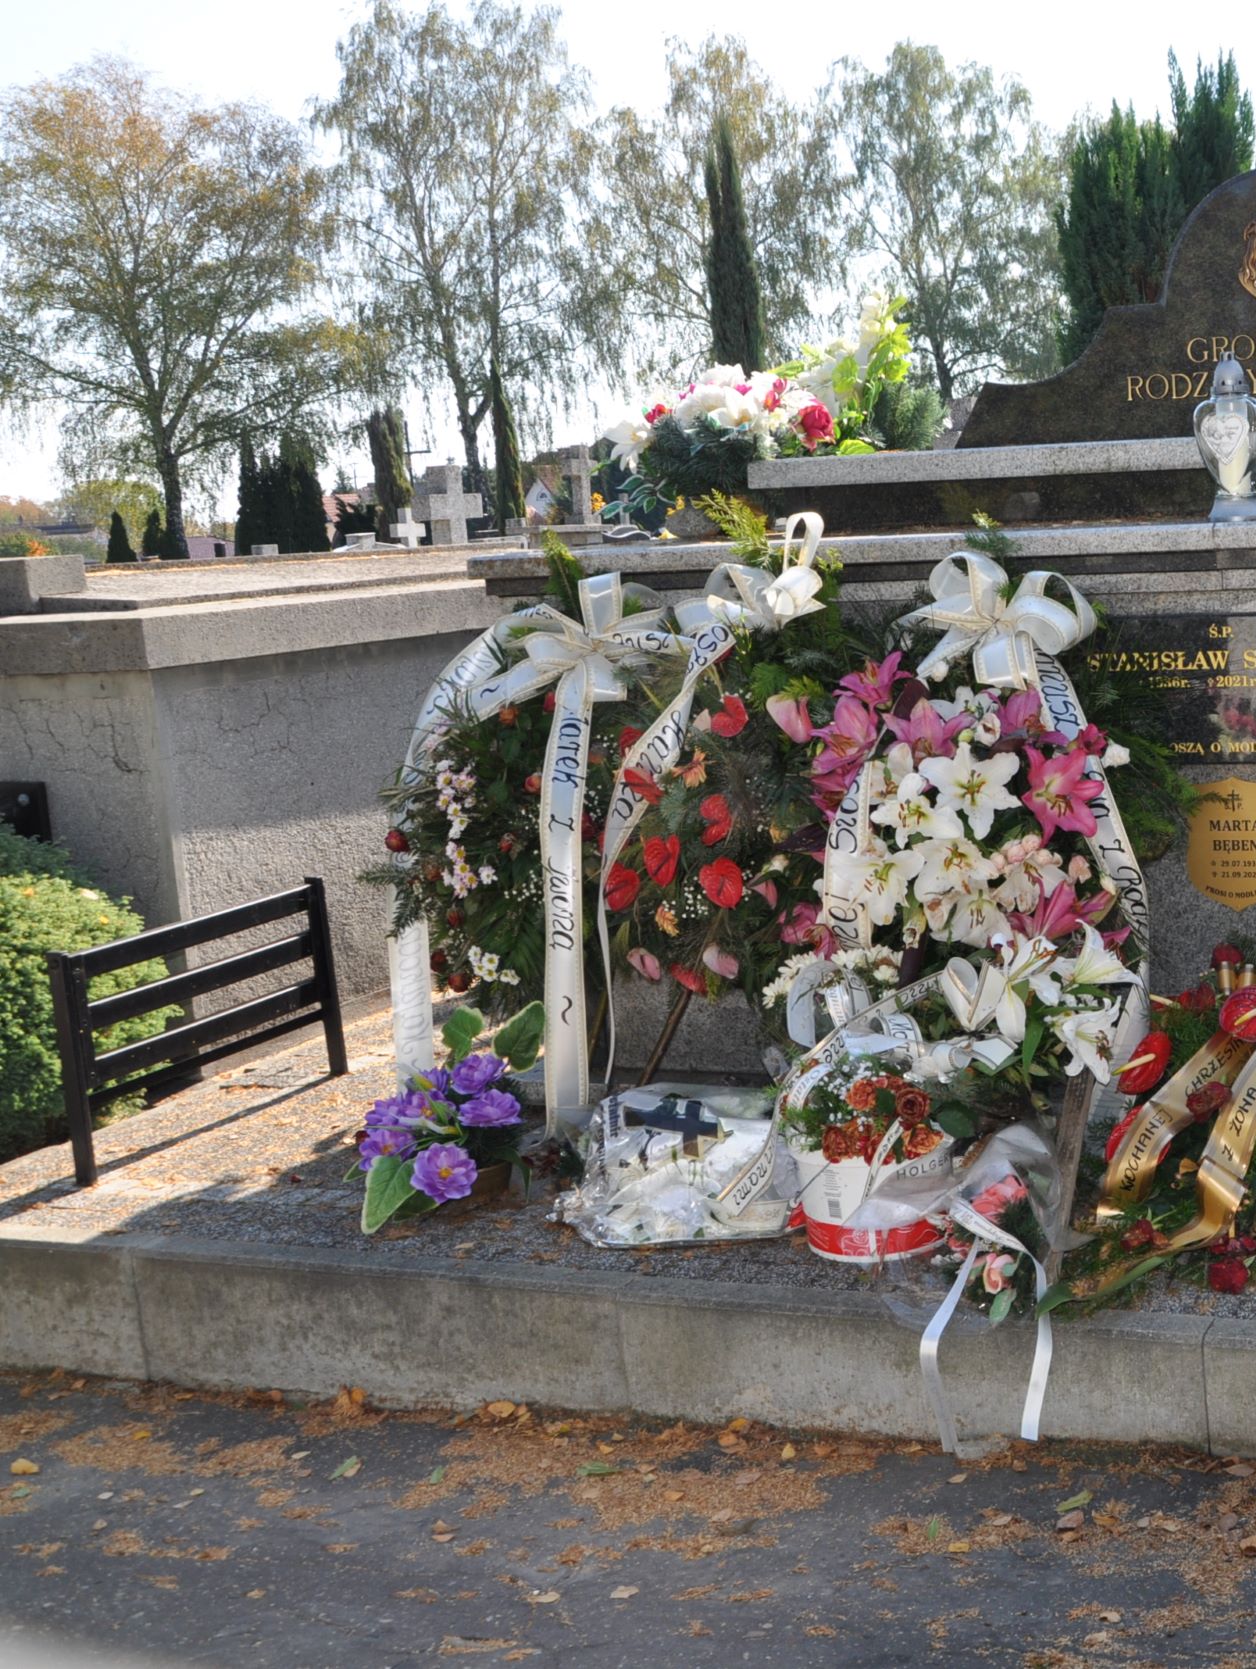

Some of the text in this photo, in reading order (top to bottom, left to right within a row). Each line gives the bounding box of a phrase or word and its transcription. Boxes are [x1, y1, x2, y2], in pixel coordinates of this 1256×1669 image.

[1208, 623, 1235, 638] Ś.P.
[1211, 742, 1222, 753] O
[1119, 1109, 1174, 1193] KOCHANEJ
